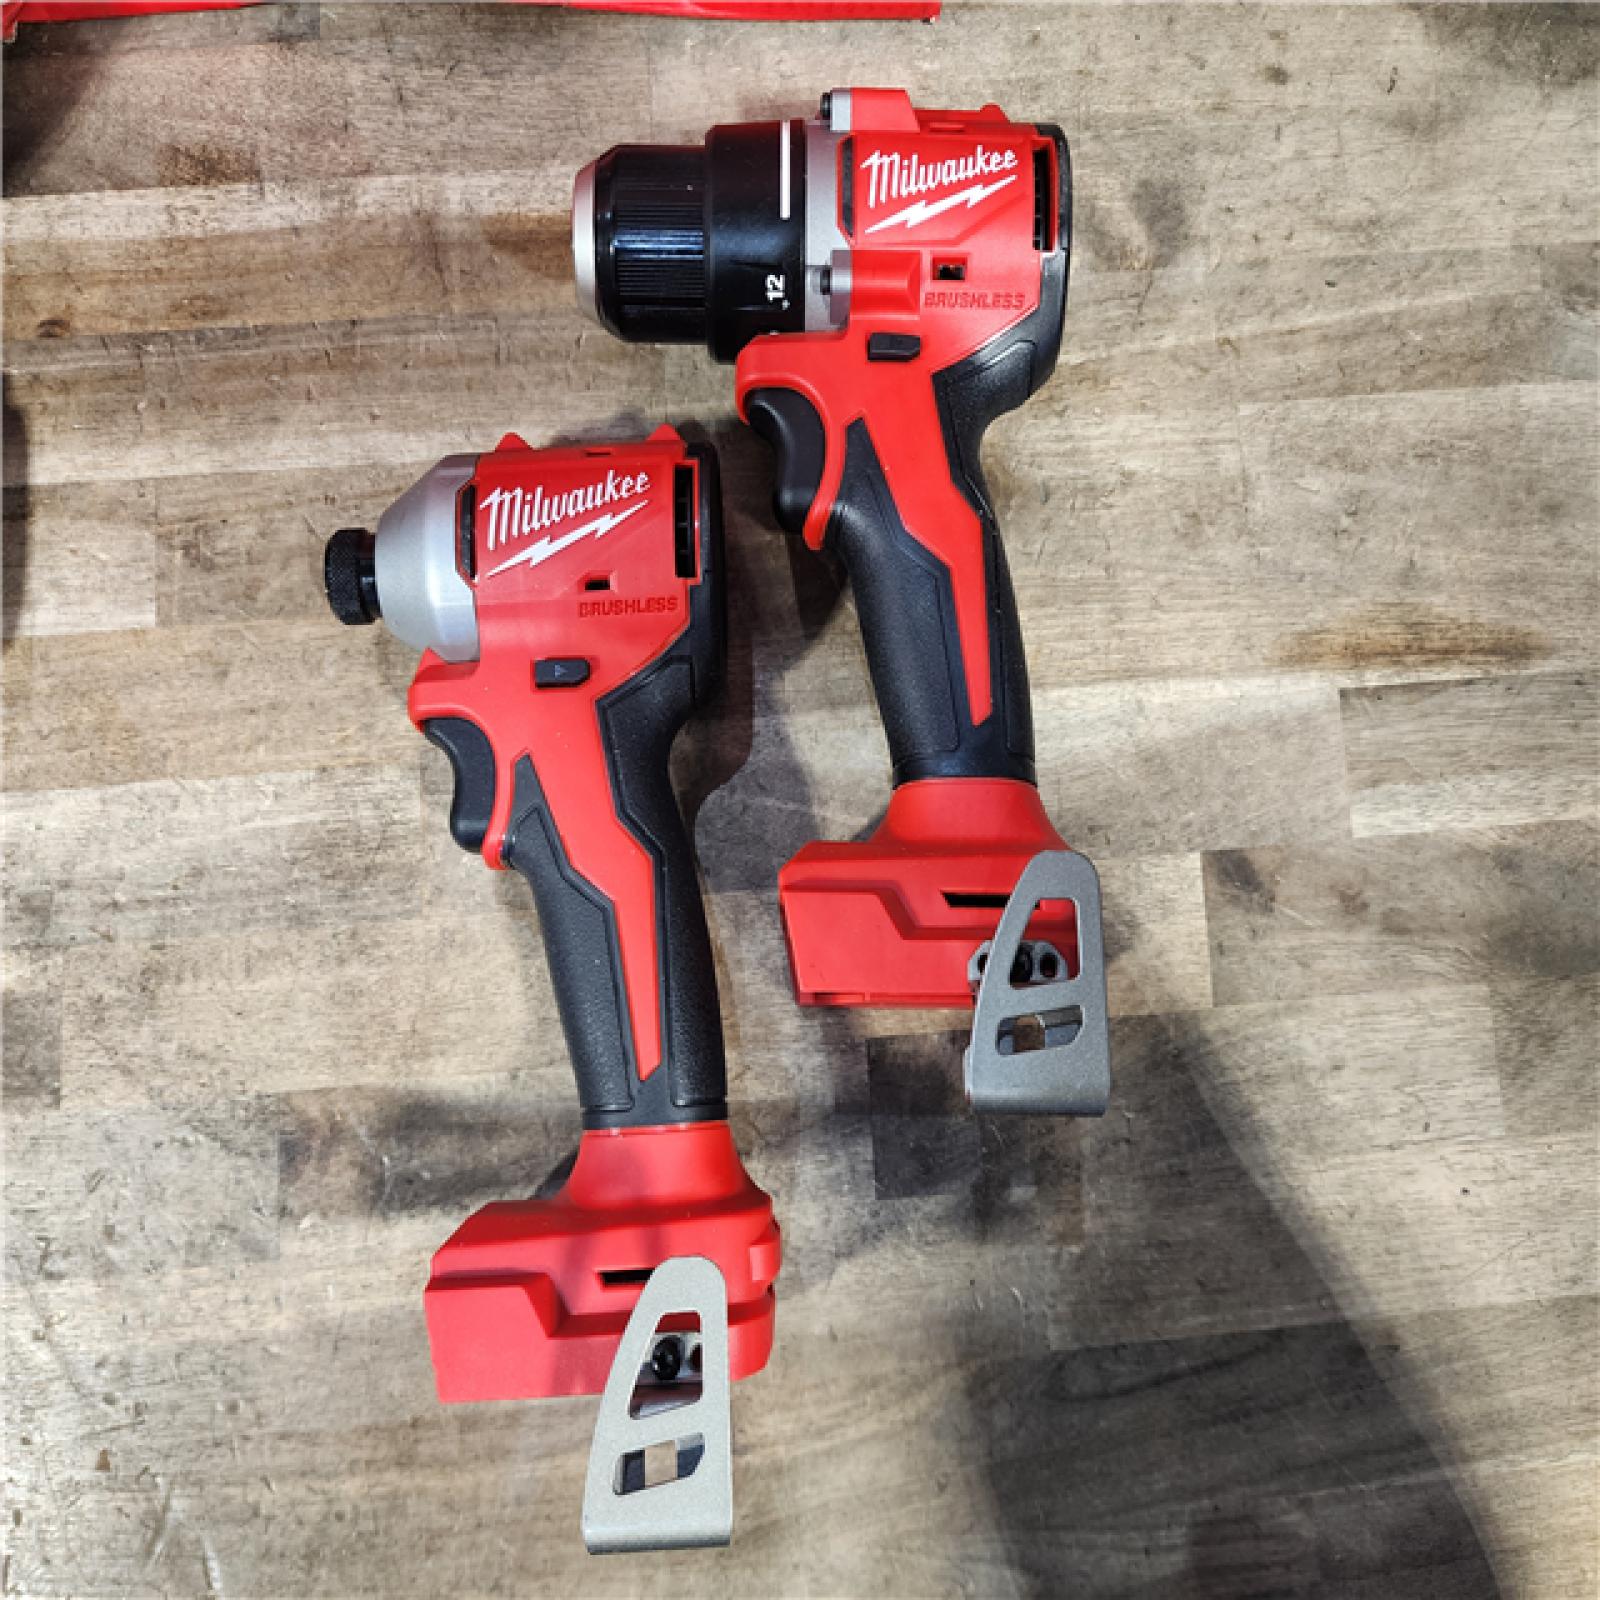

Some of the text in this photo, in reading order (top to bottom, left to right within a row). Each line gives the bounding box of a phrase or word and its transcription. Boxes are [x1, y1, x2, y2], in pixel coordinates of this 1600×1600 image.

[860, 145, 1018, 208] Milwaukee
[765, 274, 785, 301] 12
[924, 292, 1025, 308] BRUSHLESS
[480, 469, 650, 550] Milwaukee
[579, 597, 678, 617] BRUSHLESS
